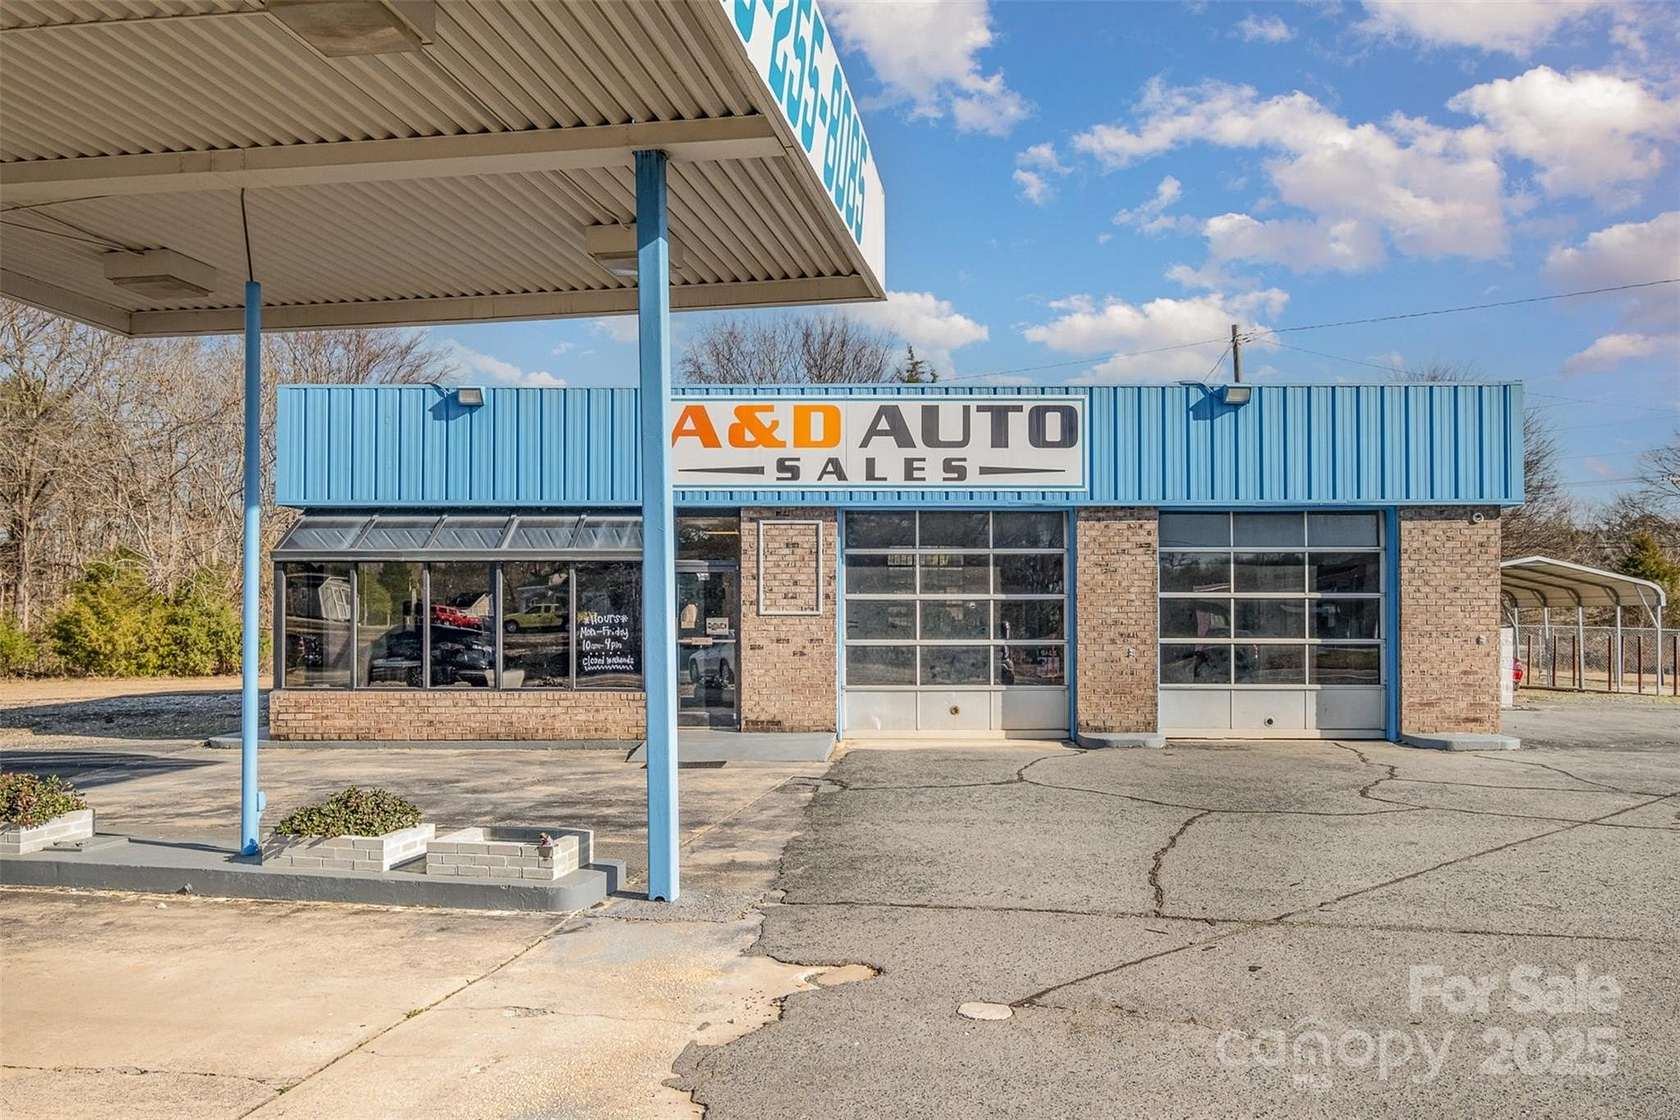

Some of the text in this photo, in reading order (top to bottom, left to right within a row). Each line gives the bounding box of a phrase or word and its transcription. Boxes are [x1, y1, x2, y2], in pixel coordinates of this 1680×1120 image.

[672, 404, 1079, 449] A&D AUTO
[776, 457, 968, 482] SALES
